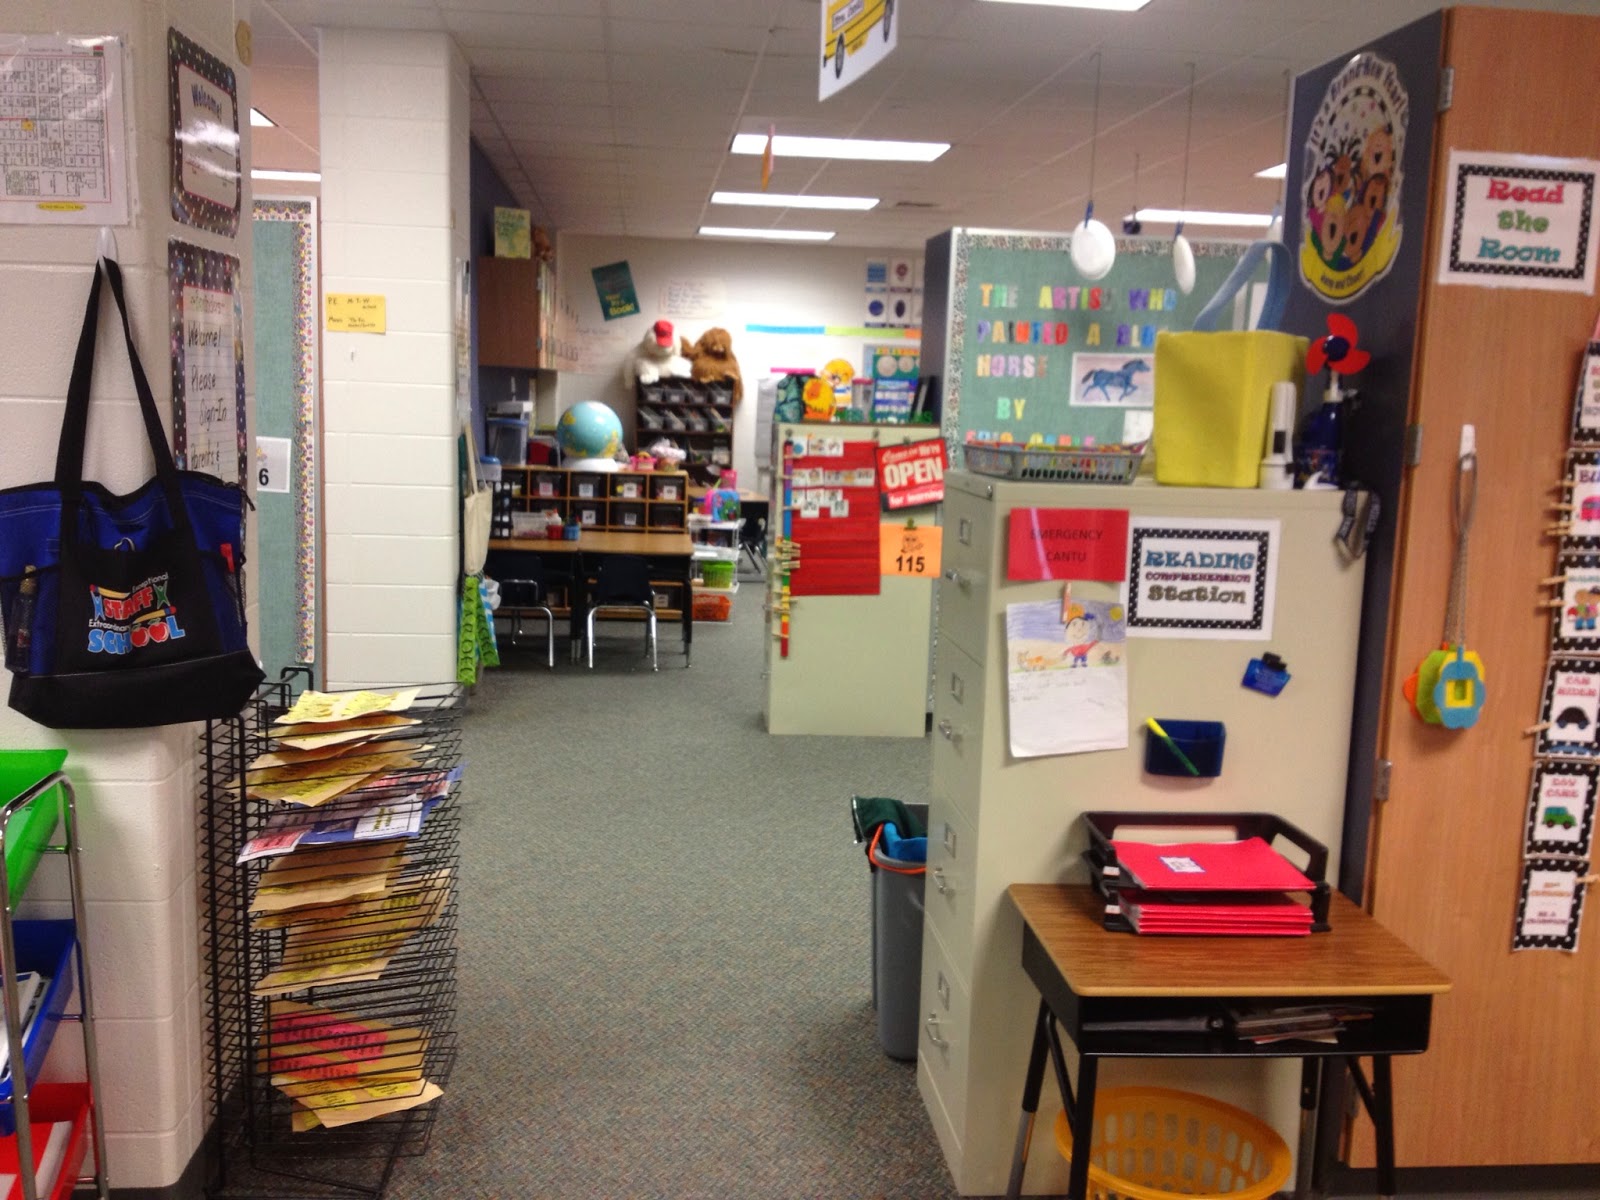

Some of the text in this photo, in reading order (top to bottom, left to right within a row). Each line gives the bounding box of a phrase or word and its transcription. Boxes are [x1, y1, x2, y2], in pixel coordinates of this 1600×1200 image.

[1487, 178, 1564, 205] Read
[1497, 209, 1549, 233] the
[1478, 237, 1562, 264] Room
[980, 283, 1177, 311] THE ARTIST WHO
[188, 320, 222, 356] Welcome!
[977, 320, 1069, 346] PAINTED
[1086, 322, 1101, 346] A
[191, 364, 216, 393] Please
[977, 353, 1048, 379] HORSE
[996, 397, 1026, 420] BY
[884, 456, 943, 489] OPEN
[889, 489, 944, 506] for learning
[1030, 529, 1103, 540] EMERGENCY
[896, 555, 926, 574] 115
[1046, 551, 1088, 562] CANTU
[1144, 550, 1256, 570] READING
[132, 572, 169, 593] Exceptional
[1147, 585, 1247, 605] Station
[103, 586, 153, 620] STAFF
[87, 615, 186, 654] SCHOOL
